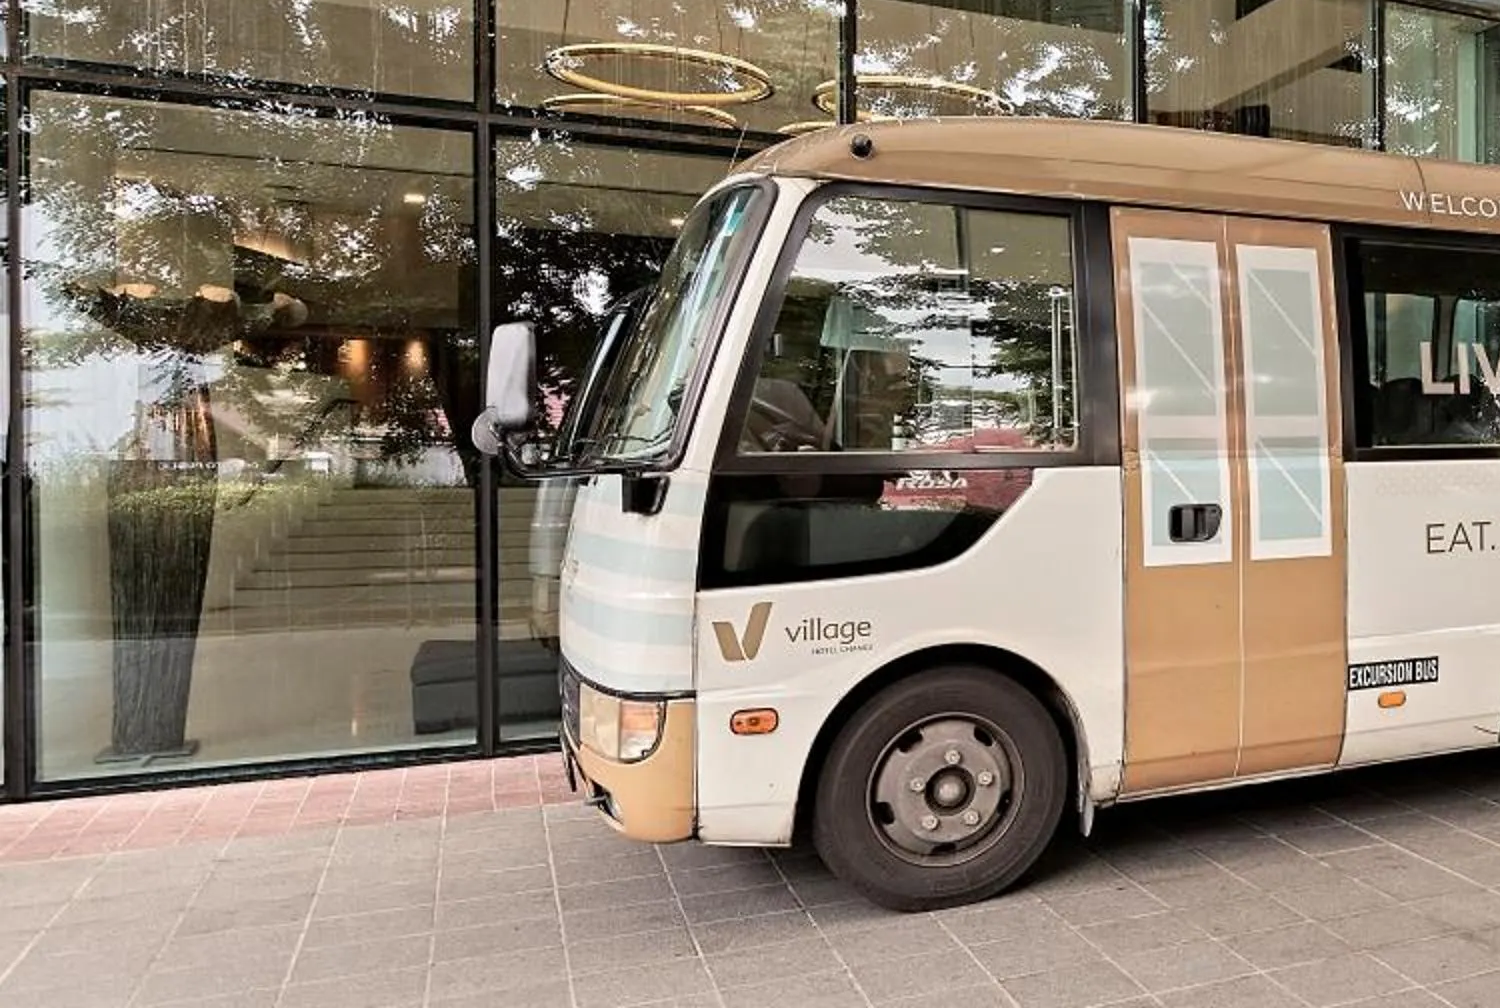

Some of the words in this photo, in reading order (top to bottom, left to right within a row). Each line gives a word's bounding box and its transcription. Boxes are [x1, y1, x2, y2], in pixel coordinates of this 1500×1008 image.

[1425, 521, 1497, 555] EAT.
[784, 617, 872, 644] village
[1349, 661, 1412, 688] EXCURSION
[1415, 659, 1437, 681] BUS
